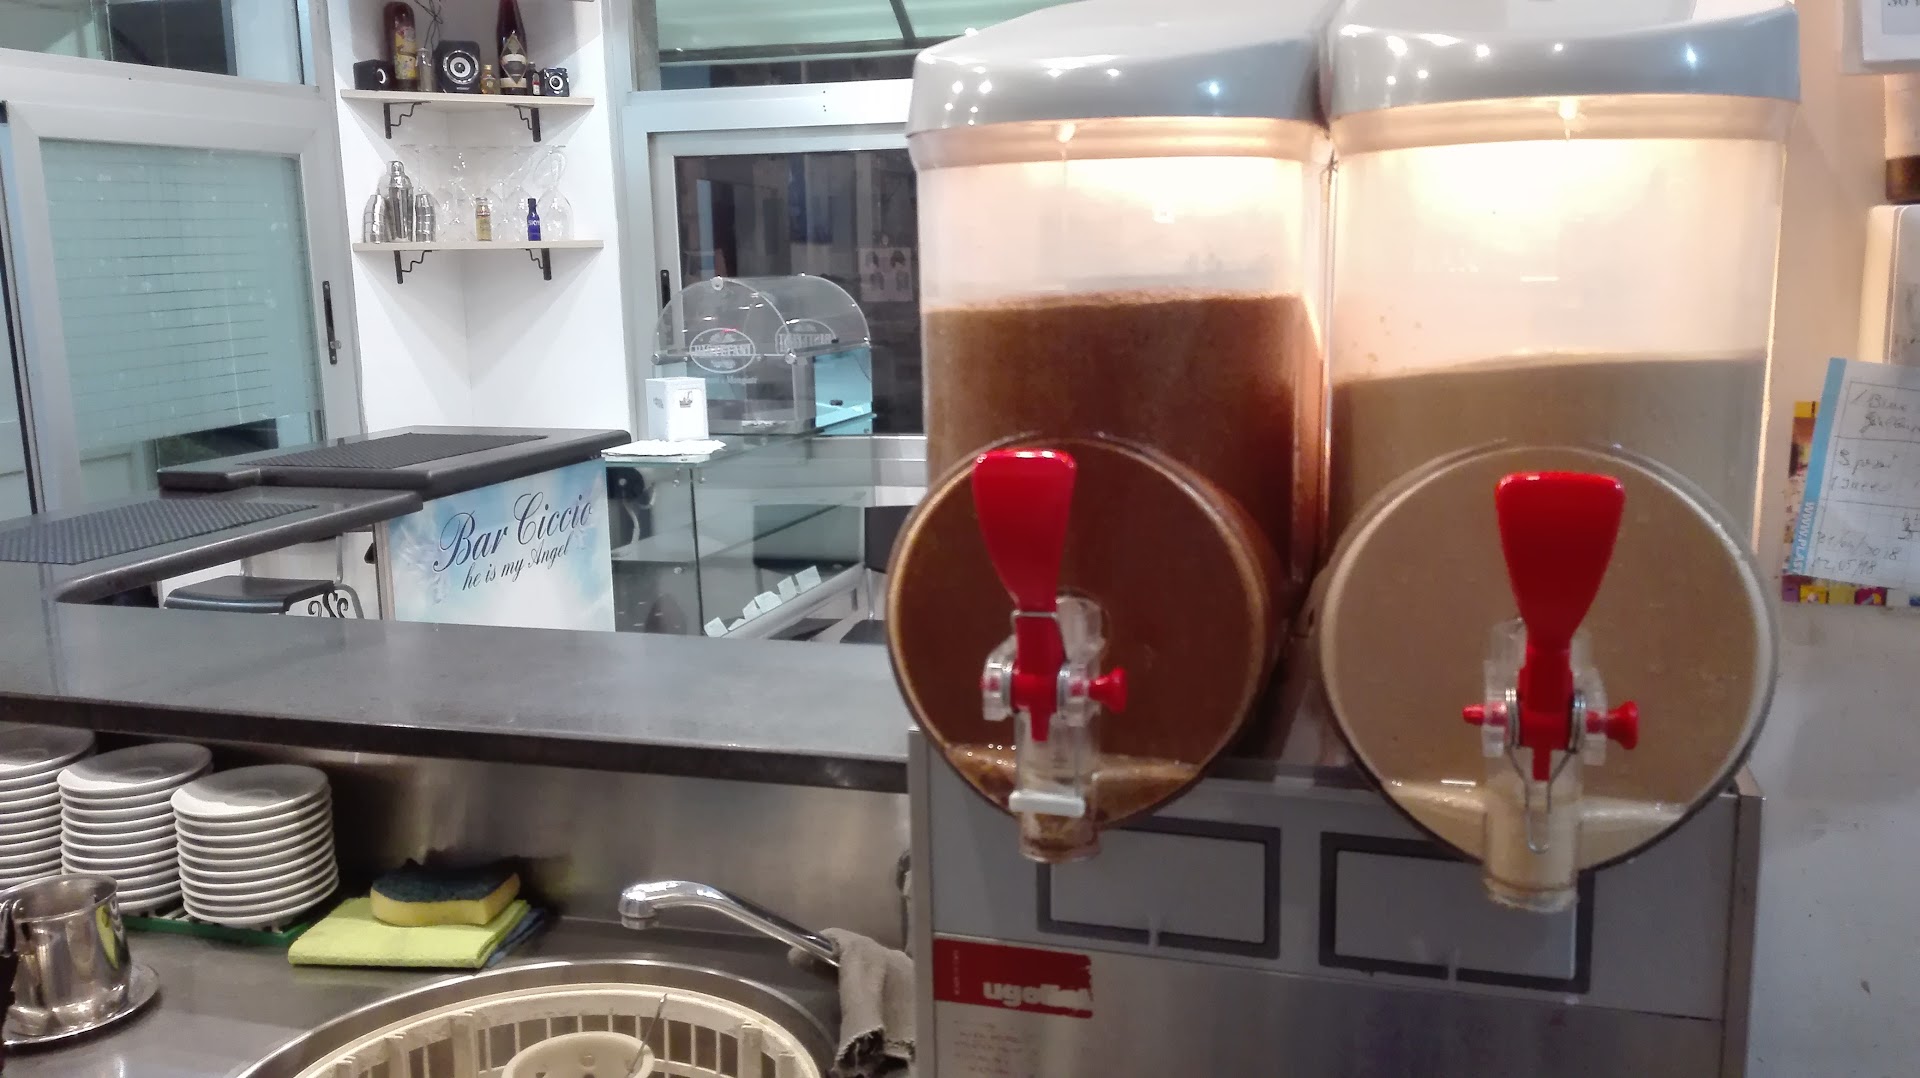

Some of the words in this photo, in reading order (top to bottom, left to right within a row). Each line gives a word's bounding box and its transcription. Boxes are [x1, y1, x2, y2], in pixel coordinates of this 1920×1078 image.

[433, 510, 508, 572] Bar
[513, 492, 592, 545] Ciccio
[462, 562, 481, 591] he
[485, 564, 497, 584] is
[501, 558, 524, 582] my
[528, 531, 573, 570] Angel
[983, 981, 1091, 1010] ugol
